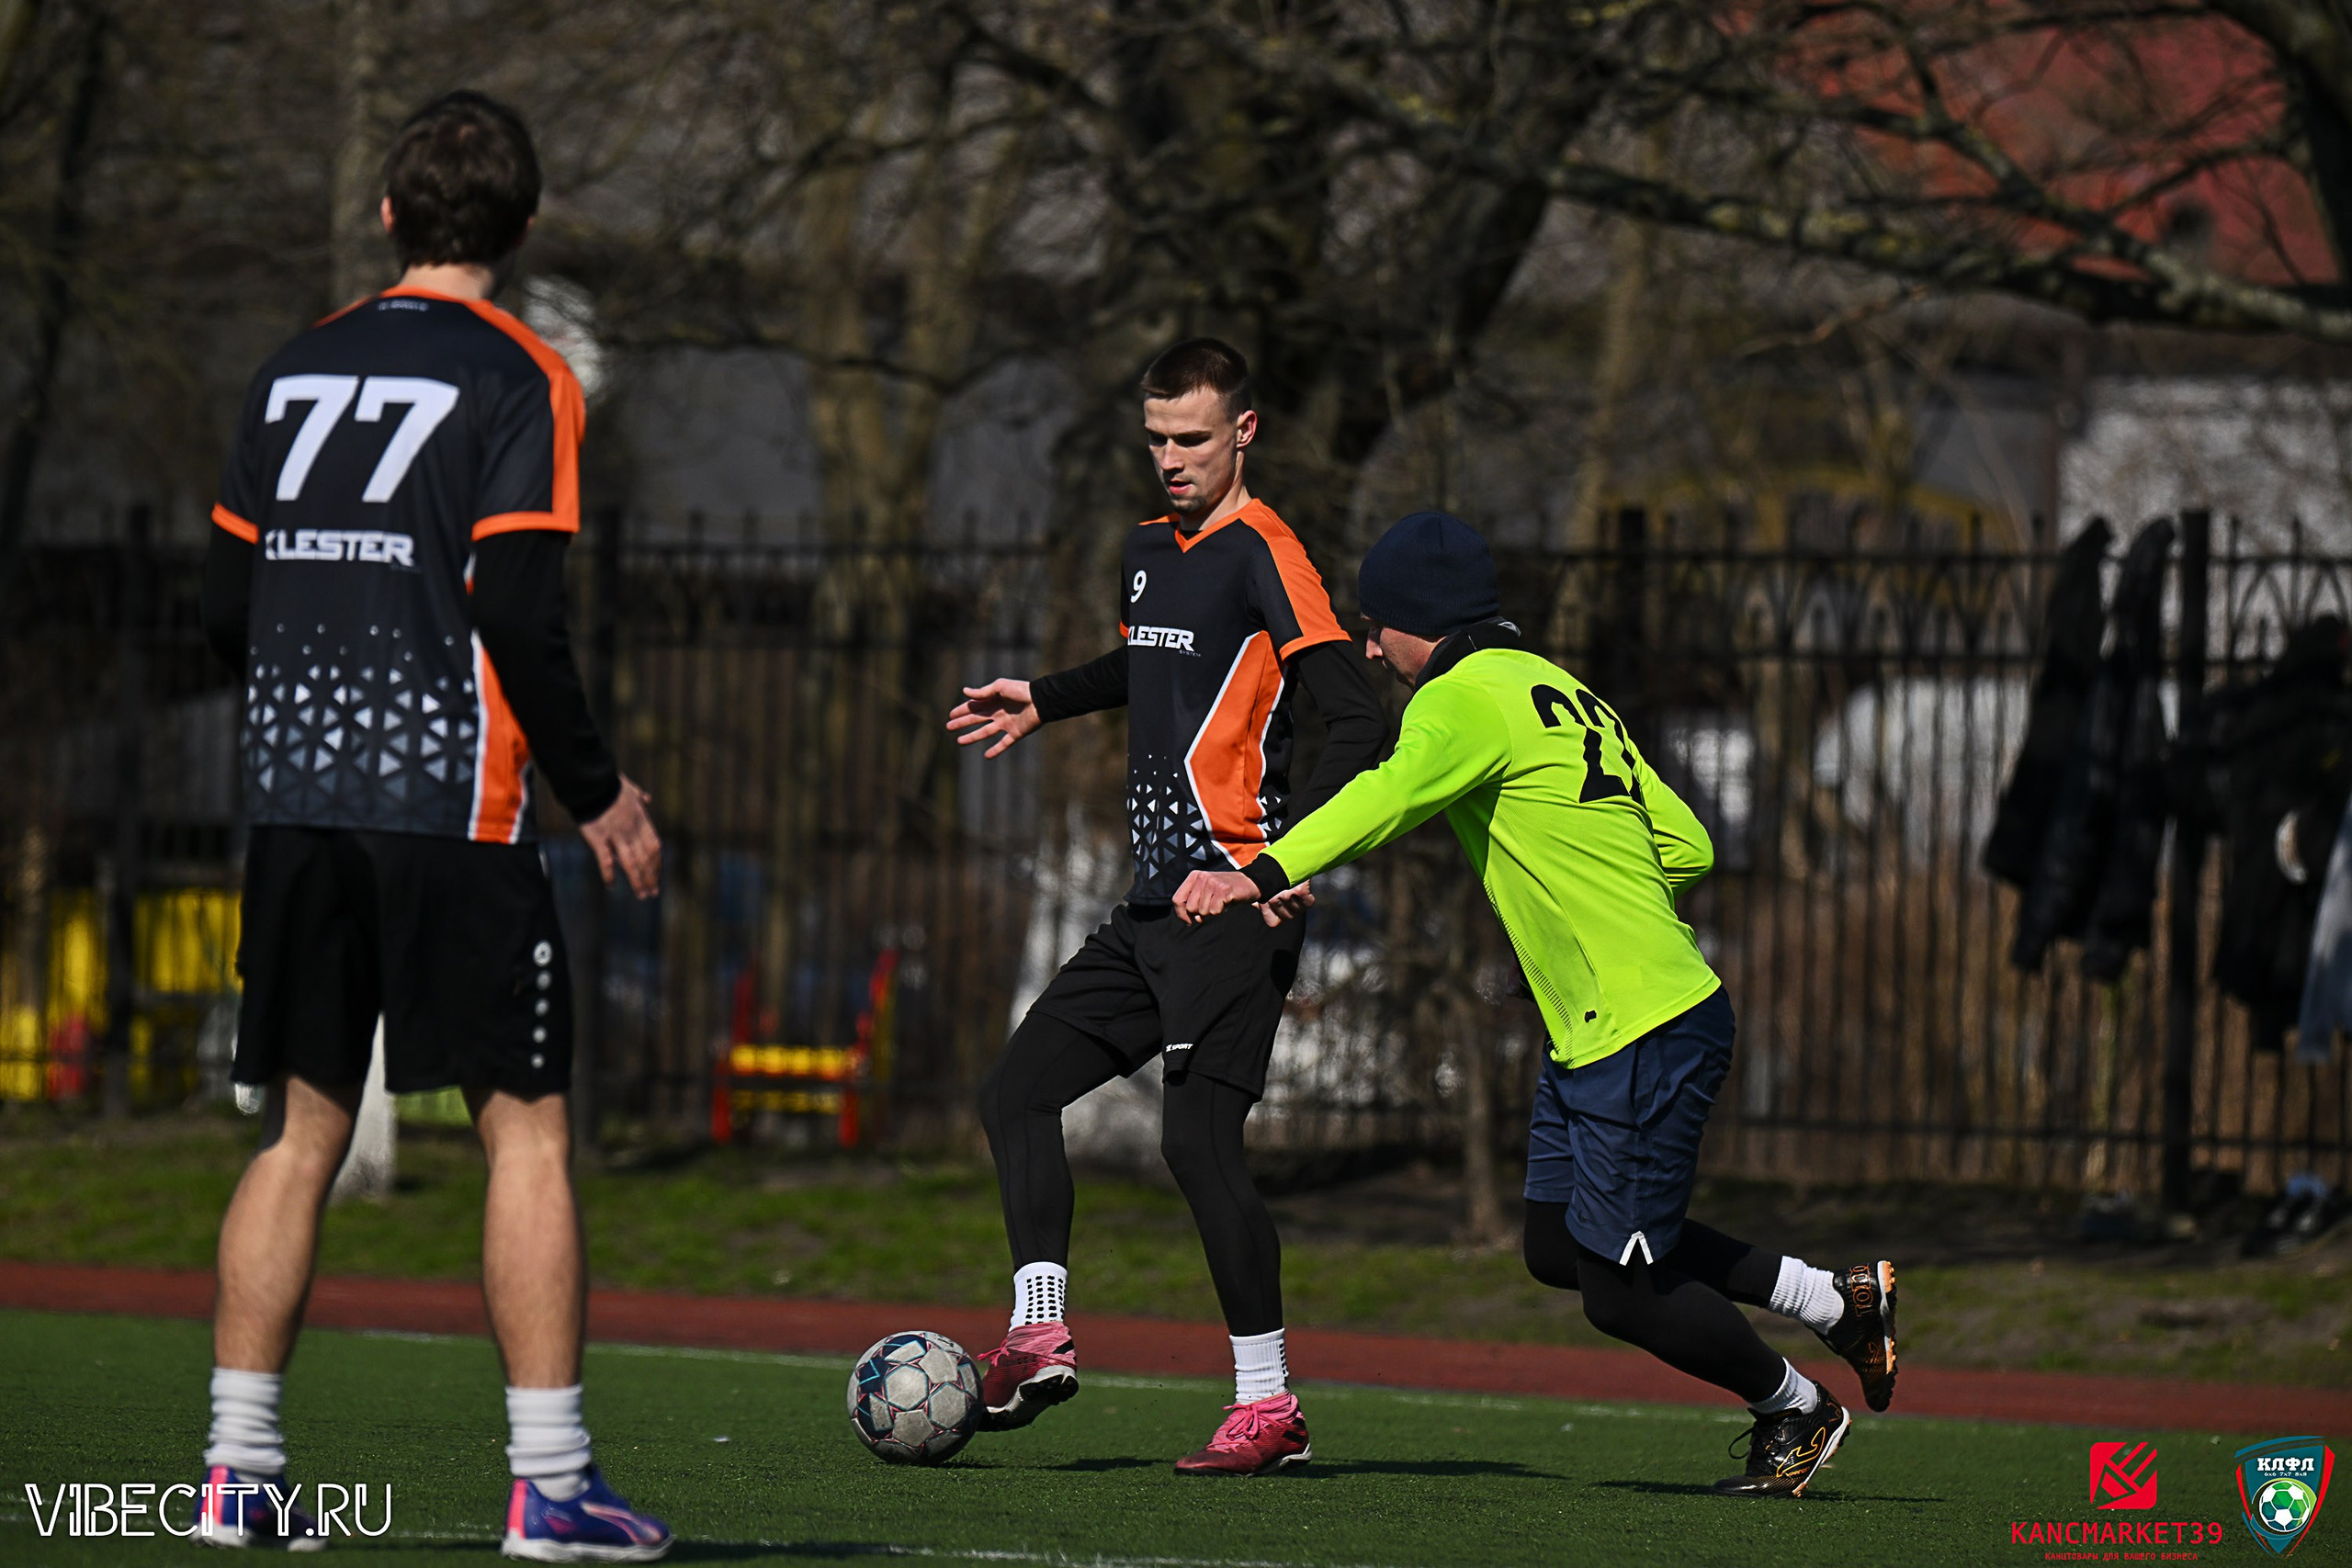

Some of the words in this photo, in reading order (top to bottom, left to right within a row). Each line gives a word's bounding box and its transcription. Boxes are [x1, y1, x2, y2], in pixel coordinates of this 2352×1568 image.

[265, 373, 460, 503] 77
[1130, 570, 1147, 603] 9
[1127, 625, 1194, 652] LESTER
